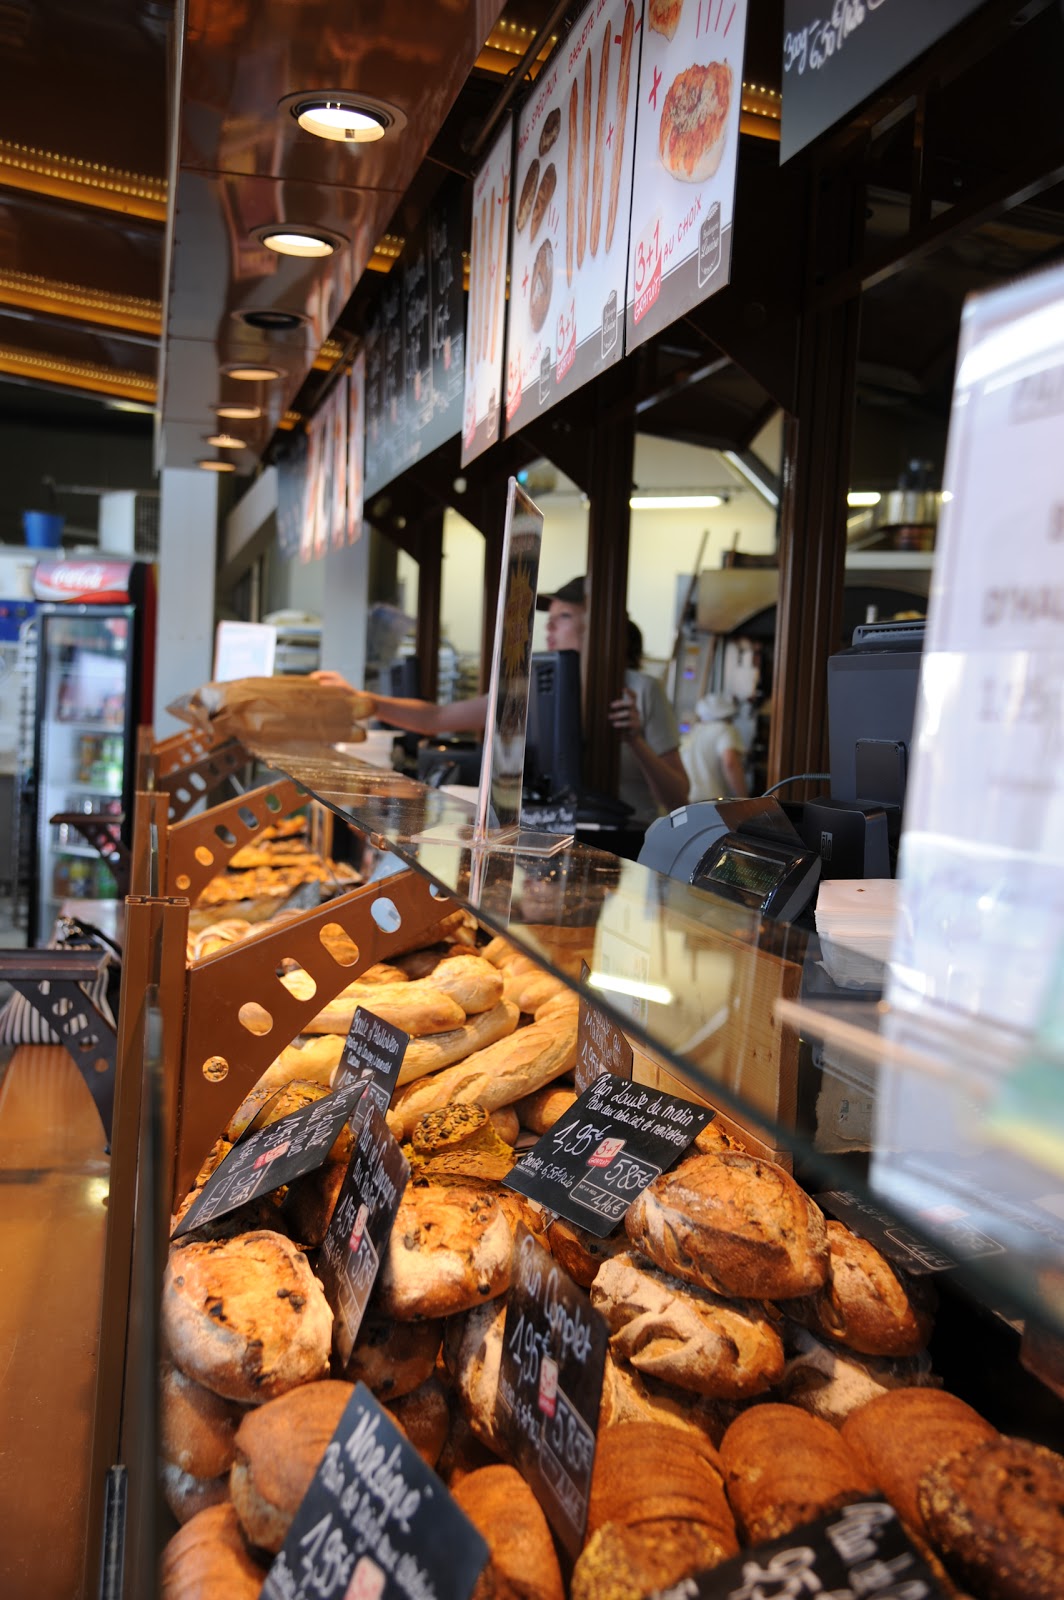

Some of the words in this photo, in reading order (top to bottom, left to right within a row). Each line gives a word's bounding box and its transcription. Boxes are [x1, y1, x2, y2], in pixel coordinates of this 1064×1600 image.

[635, 218, 659, 293] 3+1
[590, 1074, 613, 1096] Pain
[648, 1096, 662, 1115] du
[600, 1104, 615, 1116] aux
[552, 1120, 612, 1156] 1,95€
[595, 1140, 621, 1156] 3+1
[604, 1159, 652, 1190] 5,85€
